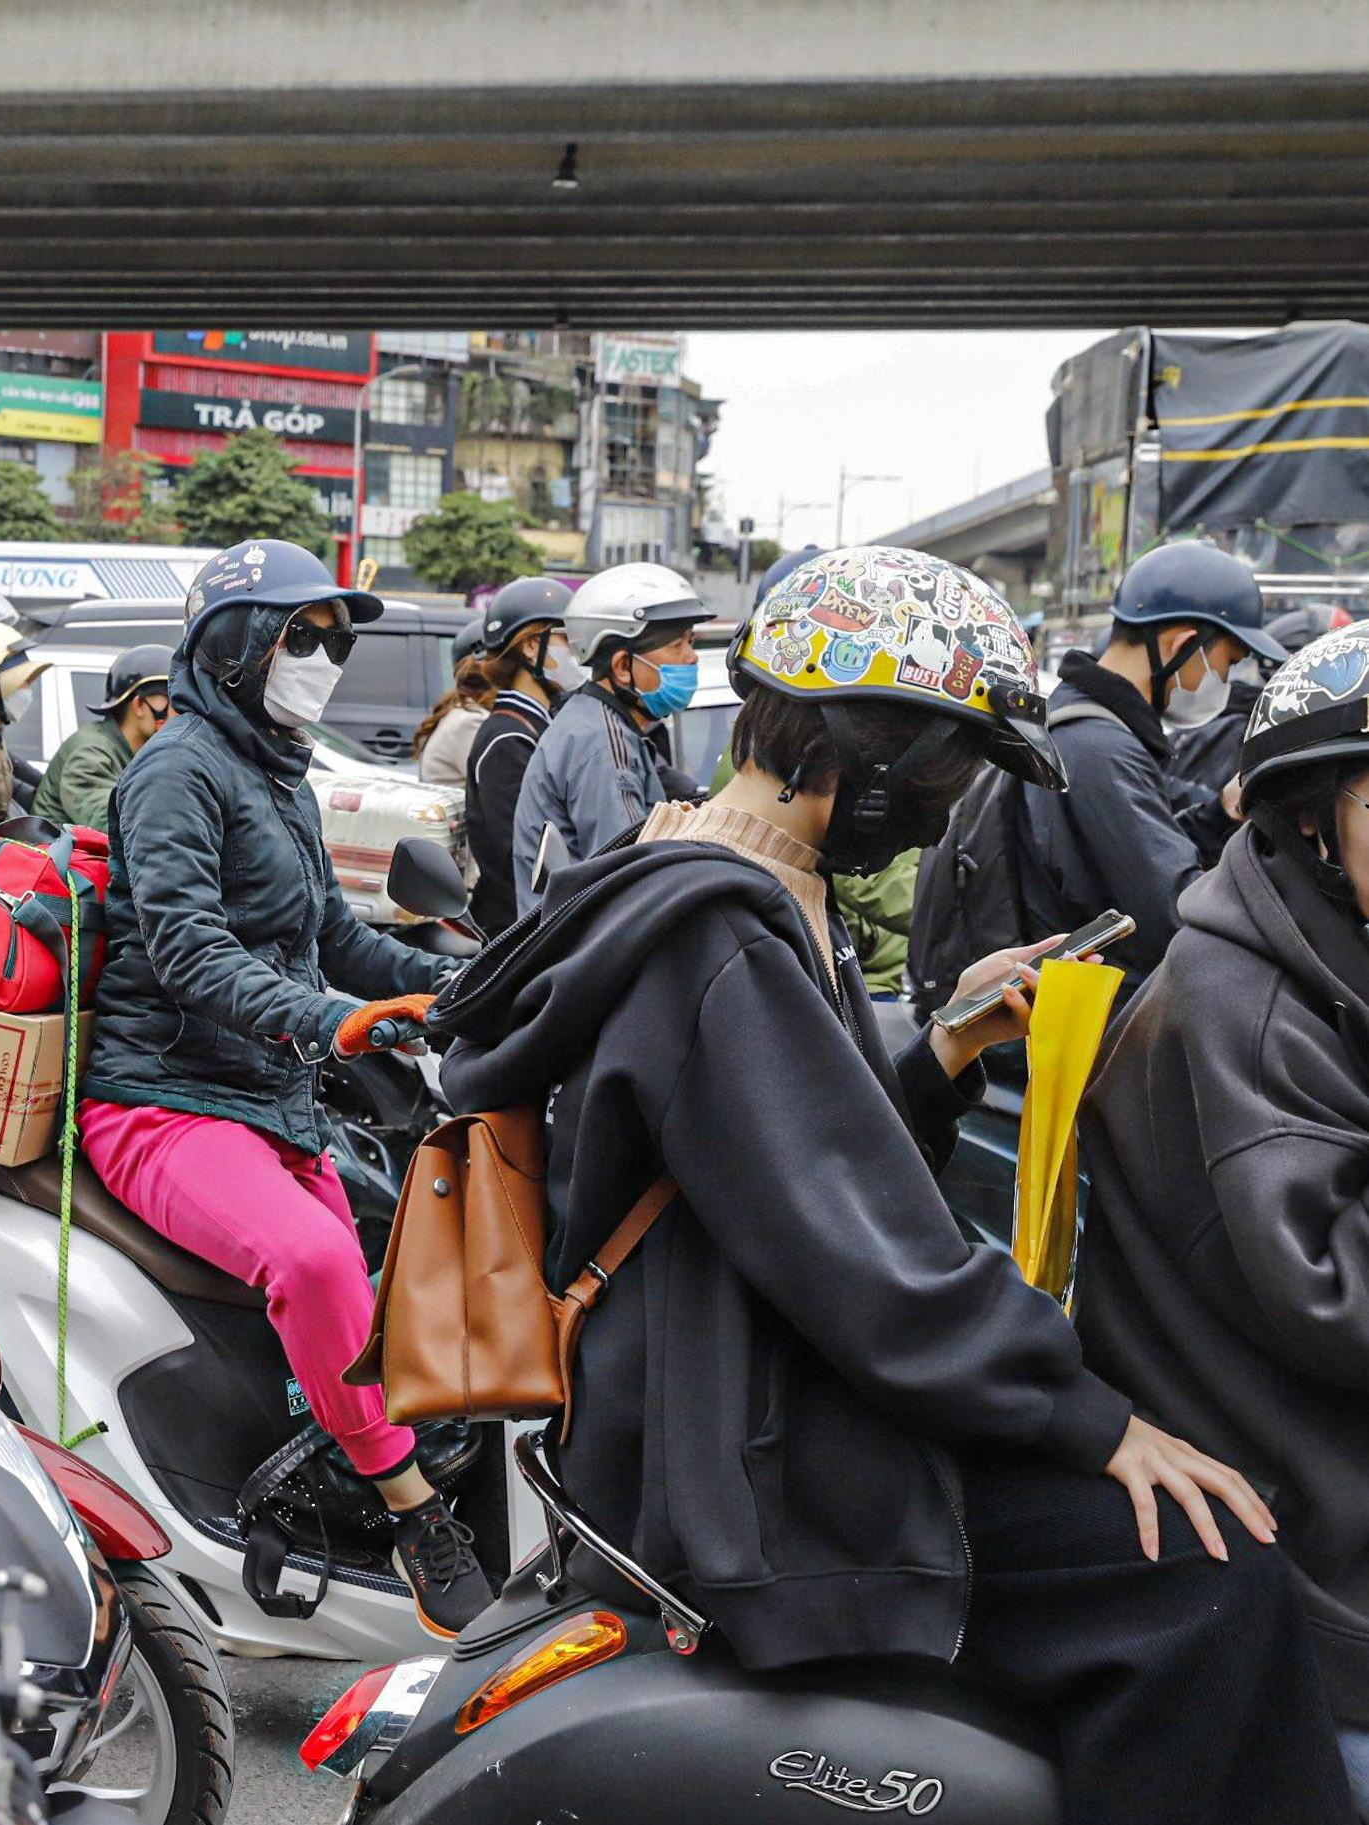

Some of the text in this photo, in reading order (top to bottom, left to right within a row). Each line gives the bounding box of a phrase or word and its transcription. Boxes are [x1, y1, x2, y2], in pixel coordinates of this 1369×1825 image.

[194, 400, 325, 434] TRẢ GÓP
[904, 665, 940, 687] BUST
